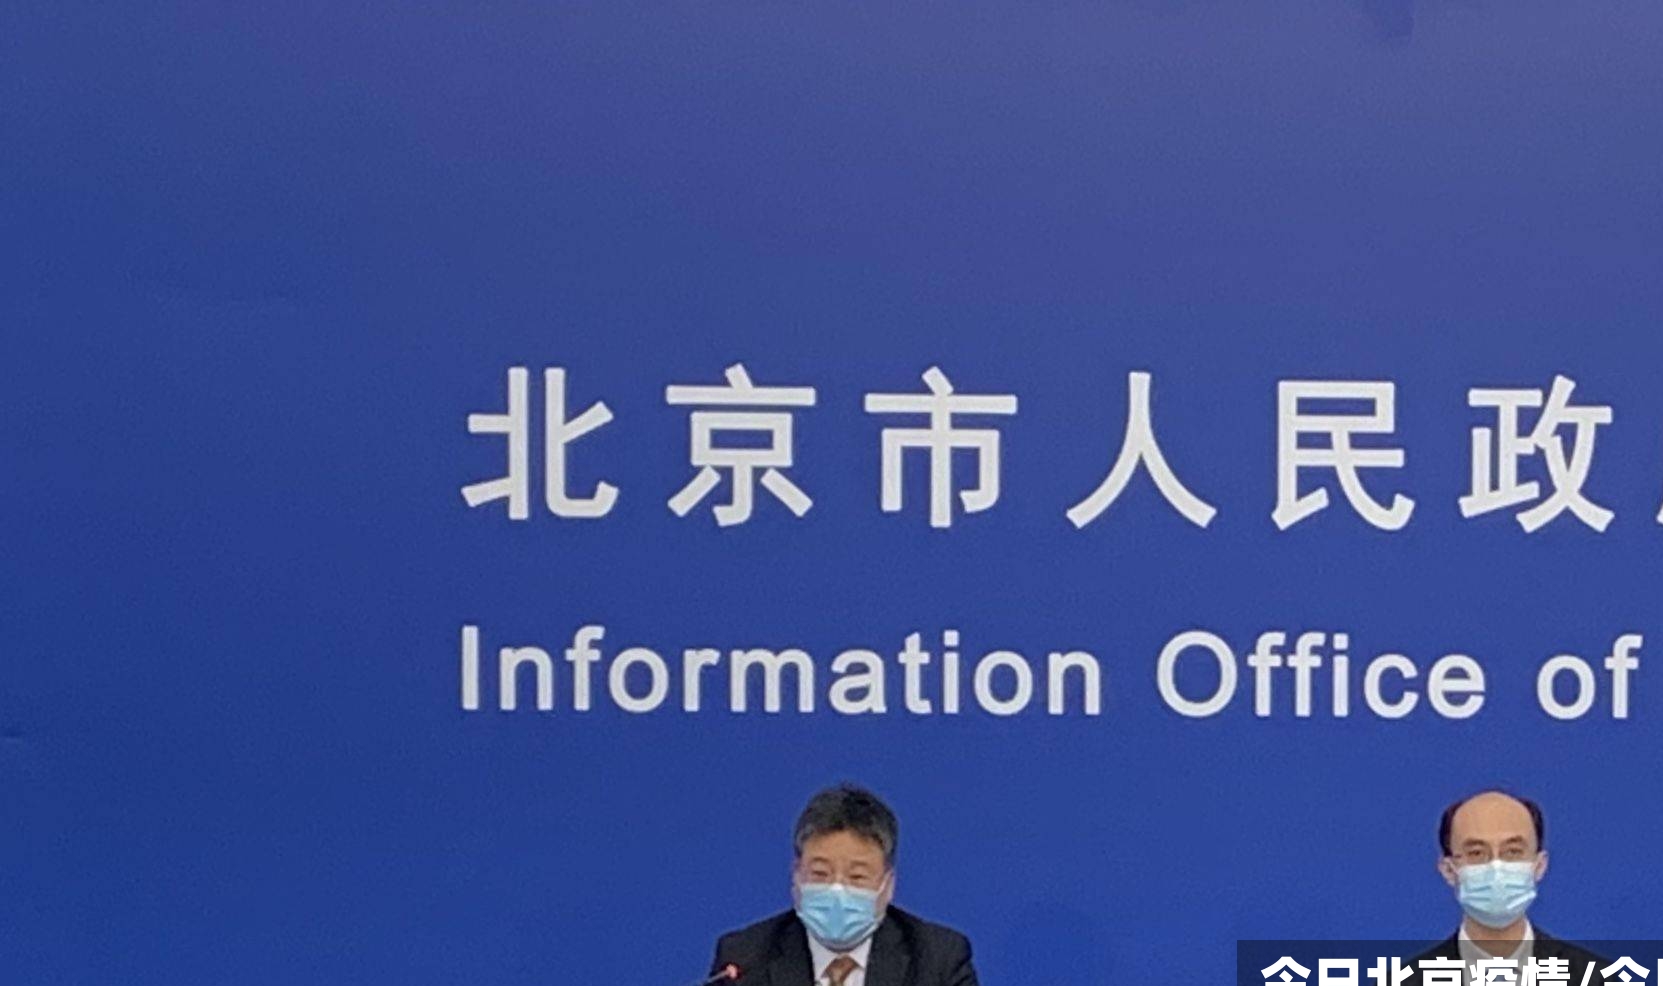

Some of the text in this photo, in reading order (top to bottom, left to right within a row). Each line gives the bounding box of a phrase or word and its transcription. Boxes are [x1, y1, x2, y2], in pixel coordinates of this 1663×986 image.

[462, 624, 1101, 715] Information
[1157, 630, 1486, 720] Office
[1537, 634, 1643, 721] of
